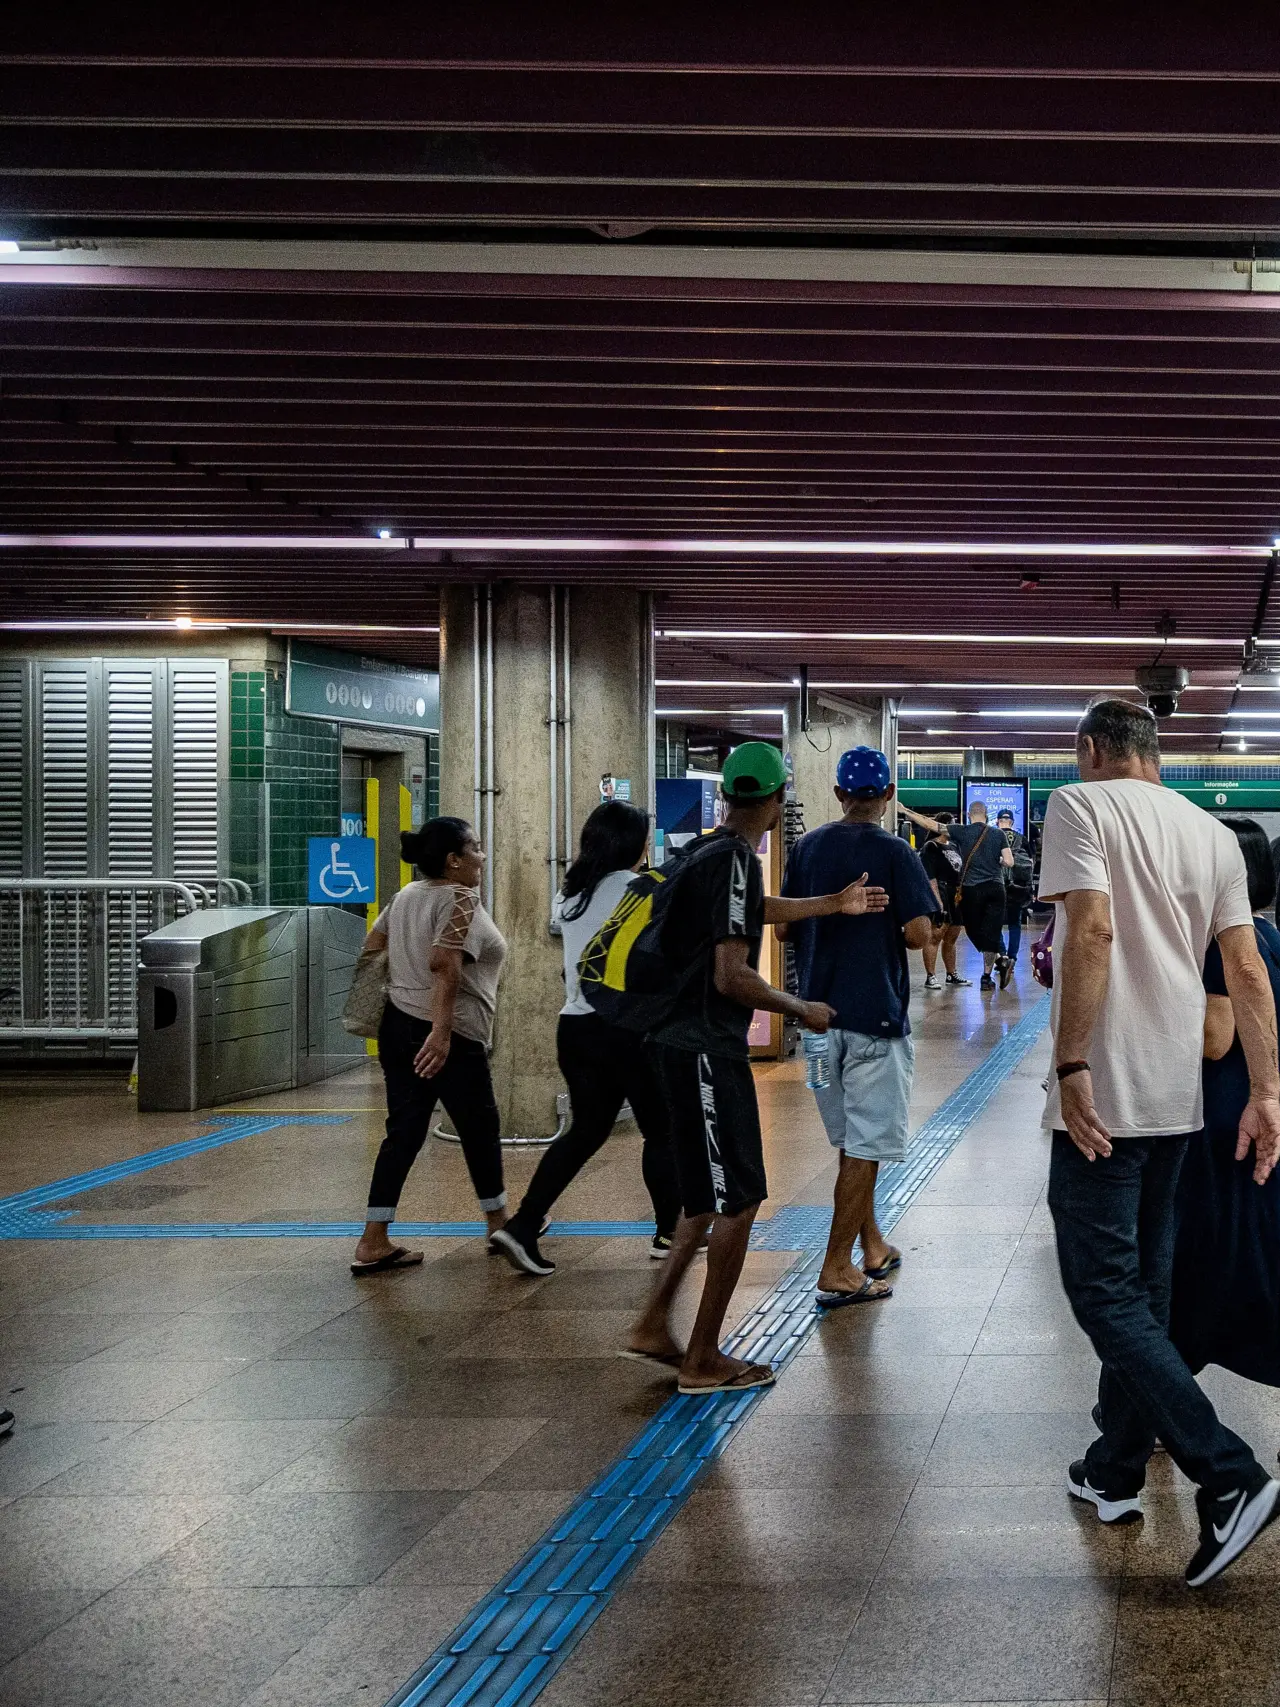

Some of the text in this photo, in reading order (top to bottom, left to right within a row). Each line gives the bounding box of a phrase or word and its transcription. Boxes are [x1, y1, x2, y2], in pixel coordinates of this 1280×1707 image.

[361, 657, 396, 676] Embarque
[401, 665, 429, 684] Boarding
[730, 893, 745, 925] NIKE
[700, 1081, 716, 1114] NIKE
[710, 1161, 727, 1193] NIKE
